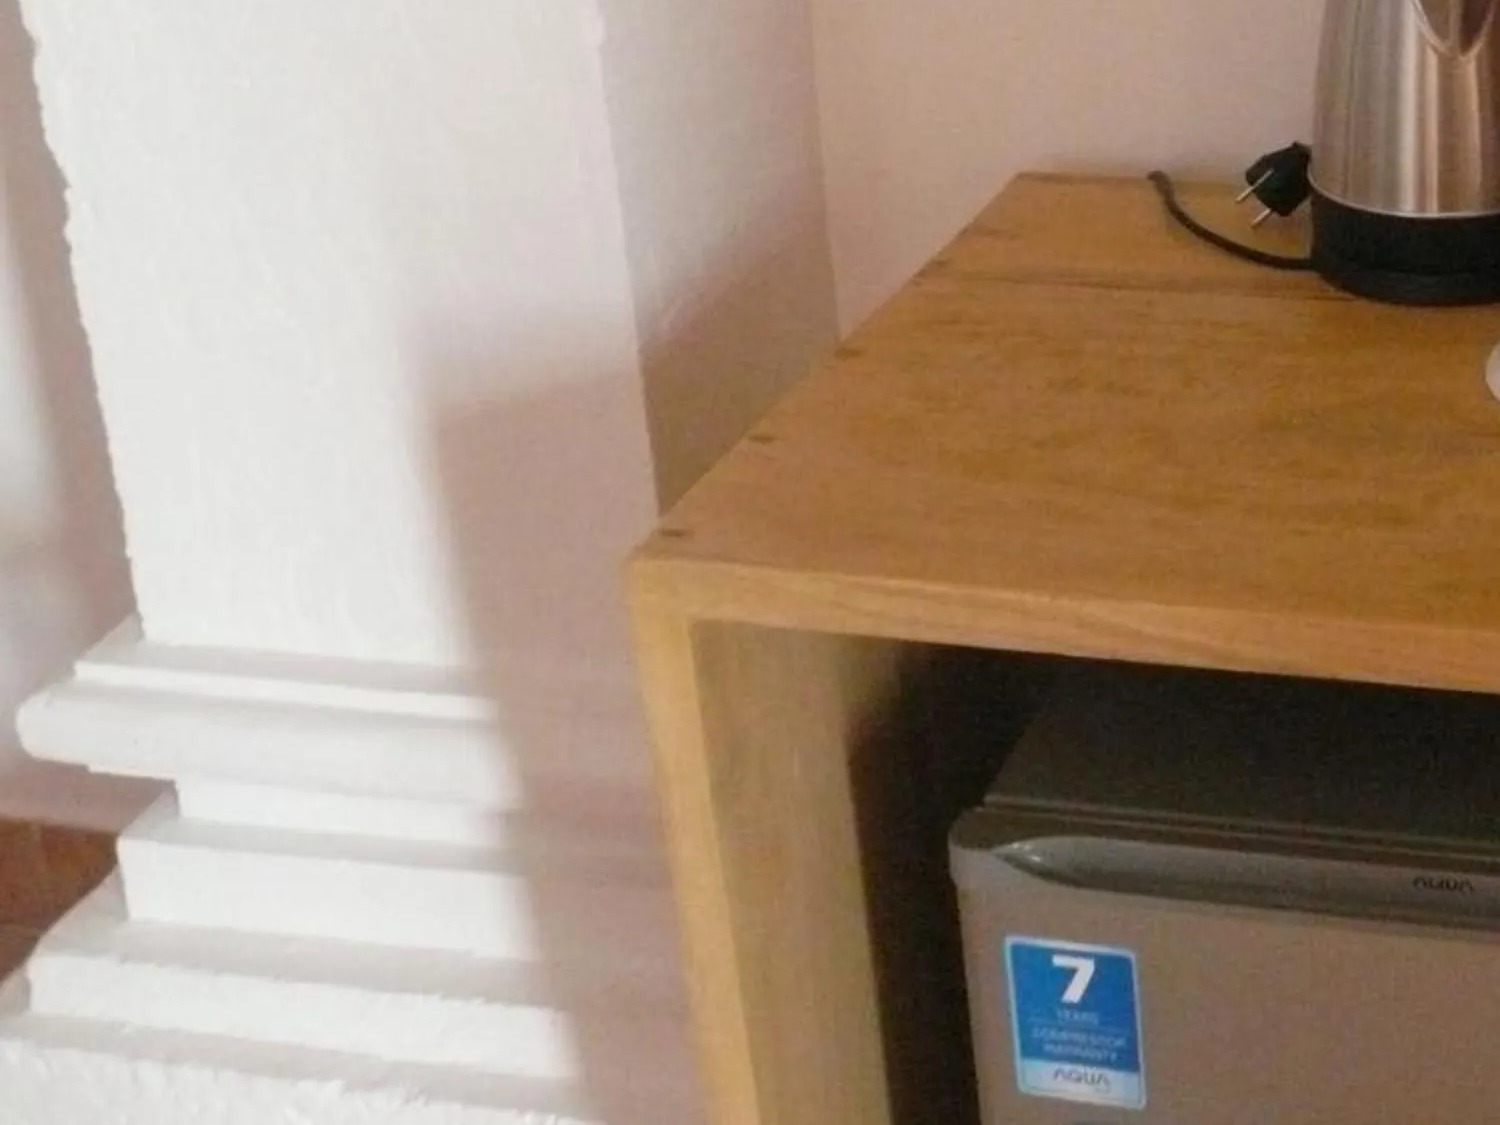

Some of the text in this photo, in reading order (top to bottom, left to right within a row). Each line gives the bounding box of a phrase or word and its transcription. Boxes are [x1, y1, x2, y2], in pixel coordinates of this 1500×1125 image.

[1412, 876, 1474, 893] AQUA
[1051, 954, 1096, 1004] 7
[1053, 1068, 1111, 1090] AQUA
